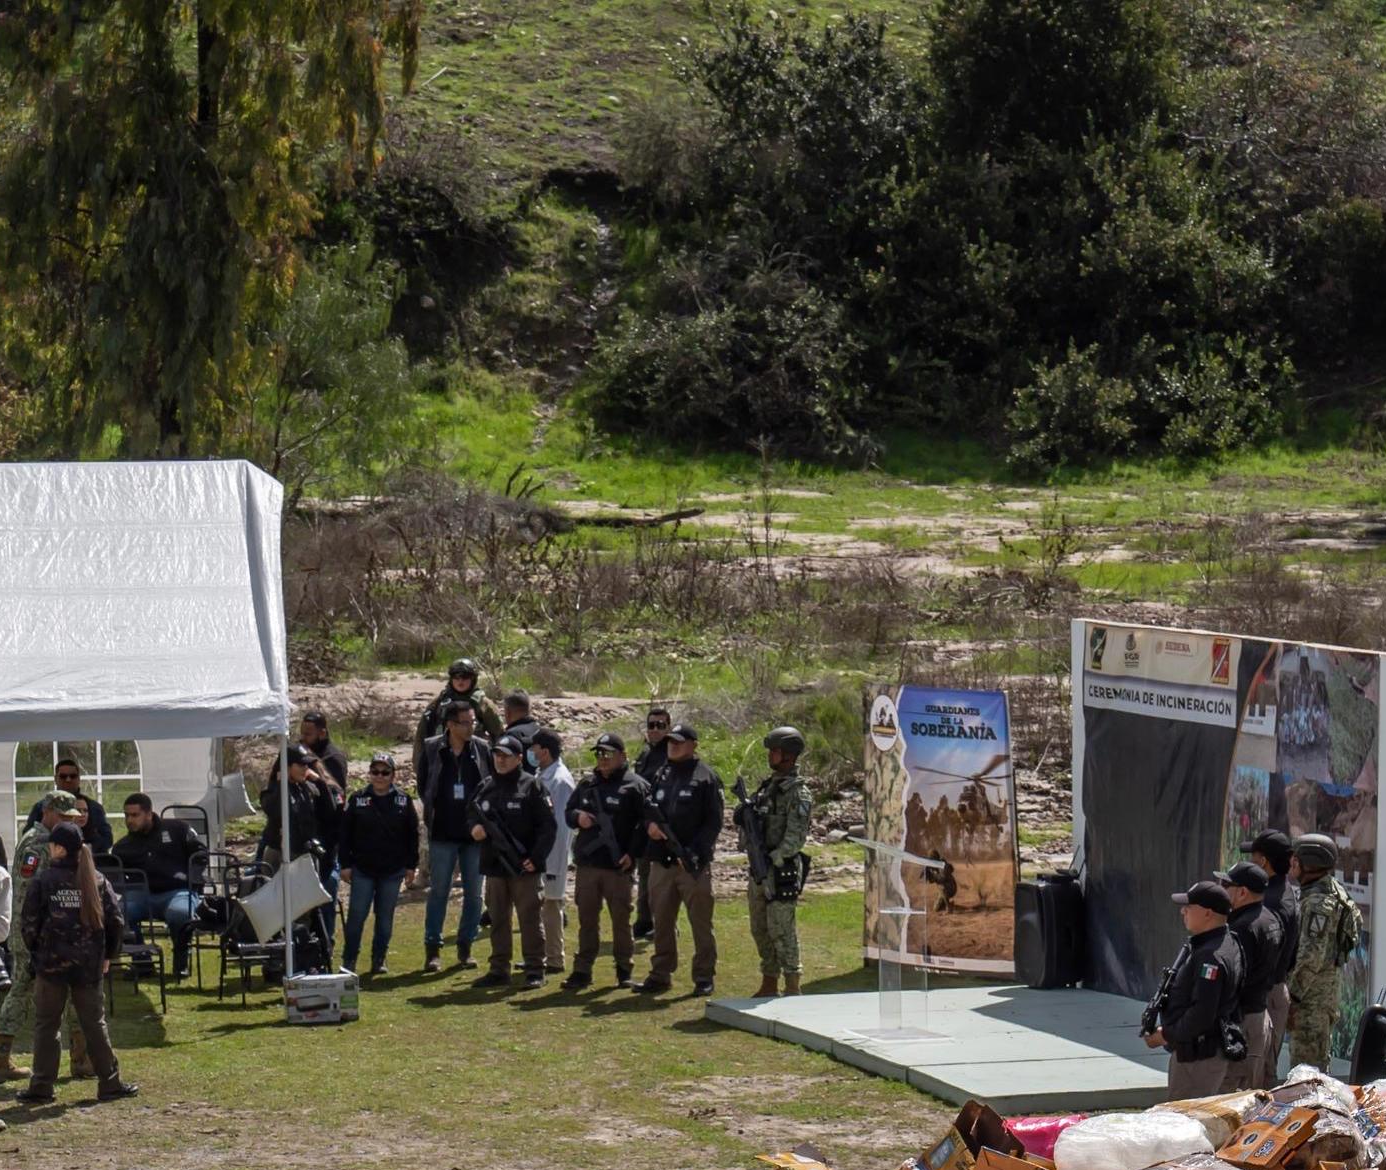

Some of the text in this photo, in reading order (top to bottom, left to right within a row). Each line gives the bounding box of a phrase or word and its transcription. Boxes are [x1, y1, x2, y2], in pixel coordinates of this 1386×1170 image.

[1089, 685, 1232, 716] CEREMONIA DE INCINERACIÓN
[925, 704, 981, 716] GUARDIANES
[941, 716, 964, 725] DE LA
[911, 722, 997, 740] SOBERANÍA
